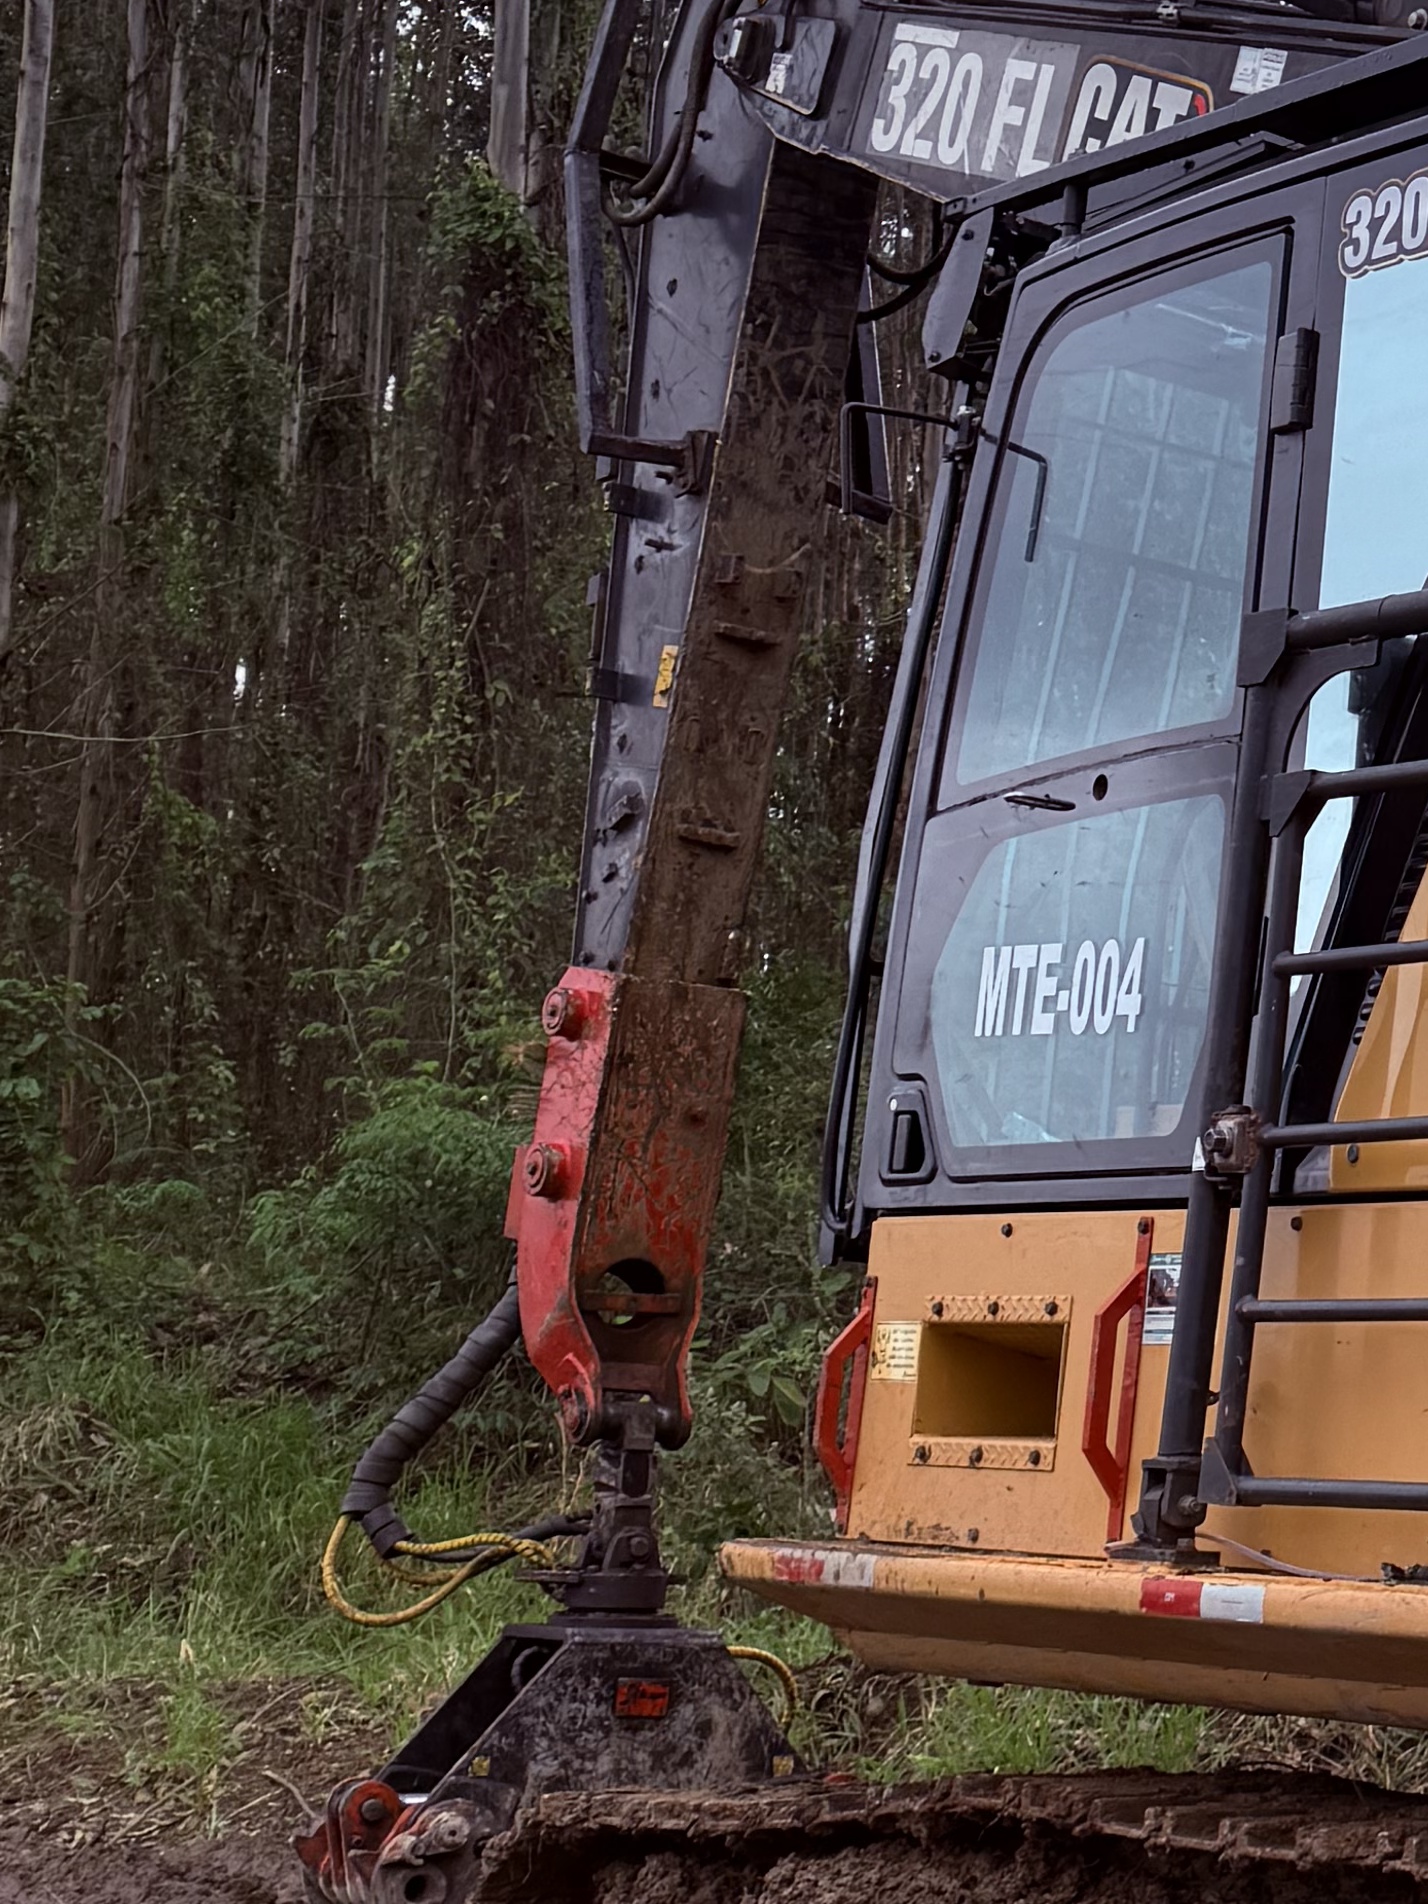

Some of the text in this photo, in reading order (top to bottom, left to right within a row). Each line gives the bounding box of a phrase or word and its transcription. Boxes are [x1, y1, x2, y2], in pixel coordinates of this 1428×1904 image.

[871, 43, 983, 165] 320
[981, 58, 1056, 178] FL
[973, 936, 1146, 1037] MTE-004
